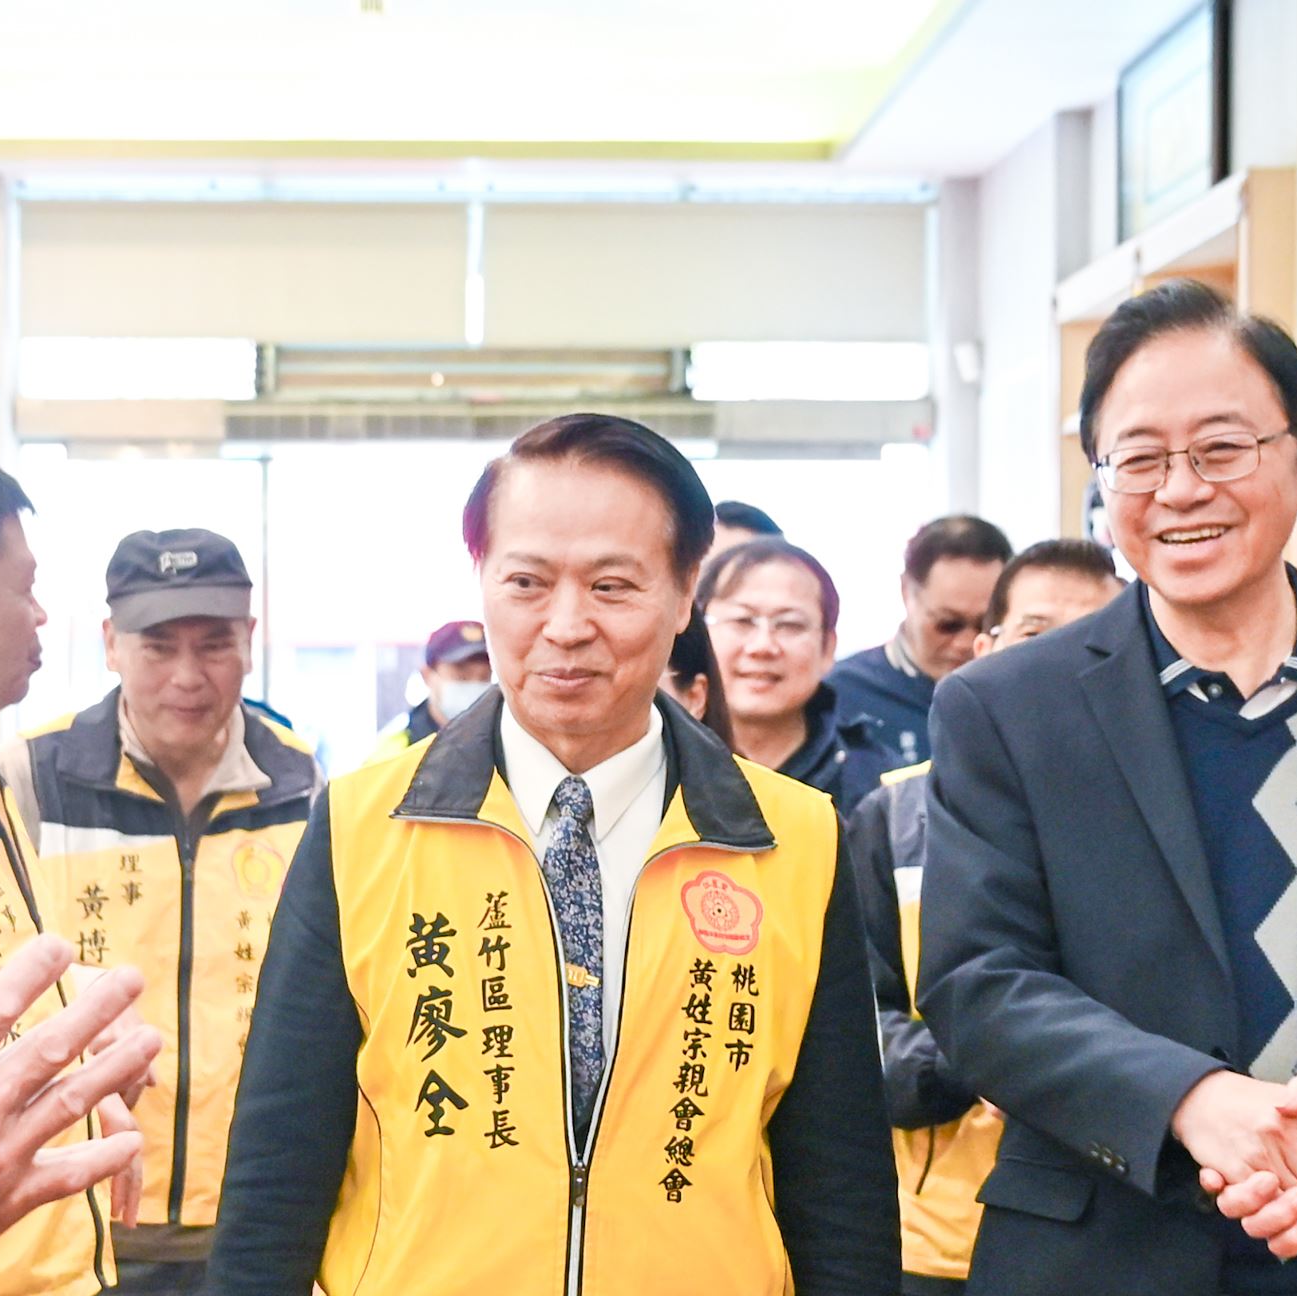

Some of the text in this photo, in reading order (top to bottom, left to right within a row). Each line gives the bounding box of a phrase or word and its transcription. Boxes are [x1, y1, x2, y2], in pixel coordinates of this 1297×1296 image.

[119, 854, 143, 906] 理事
[405, 912, 469, 1138] 黃廖全
[477, 891, 520, 1149] 蘆竹區理事長
[658, 958, 719, 1204] 黃姓宗親會總會
[724, 963, 760, 1073] 桃園市
